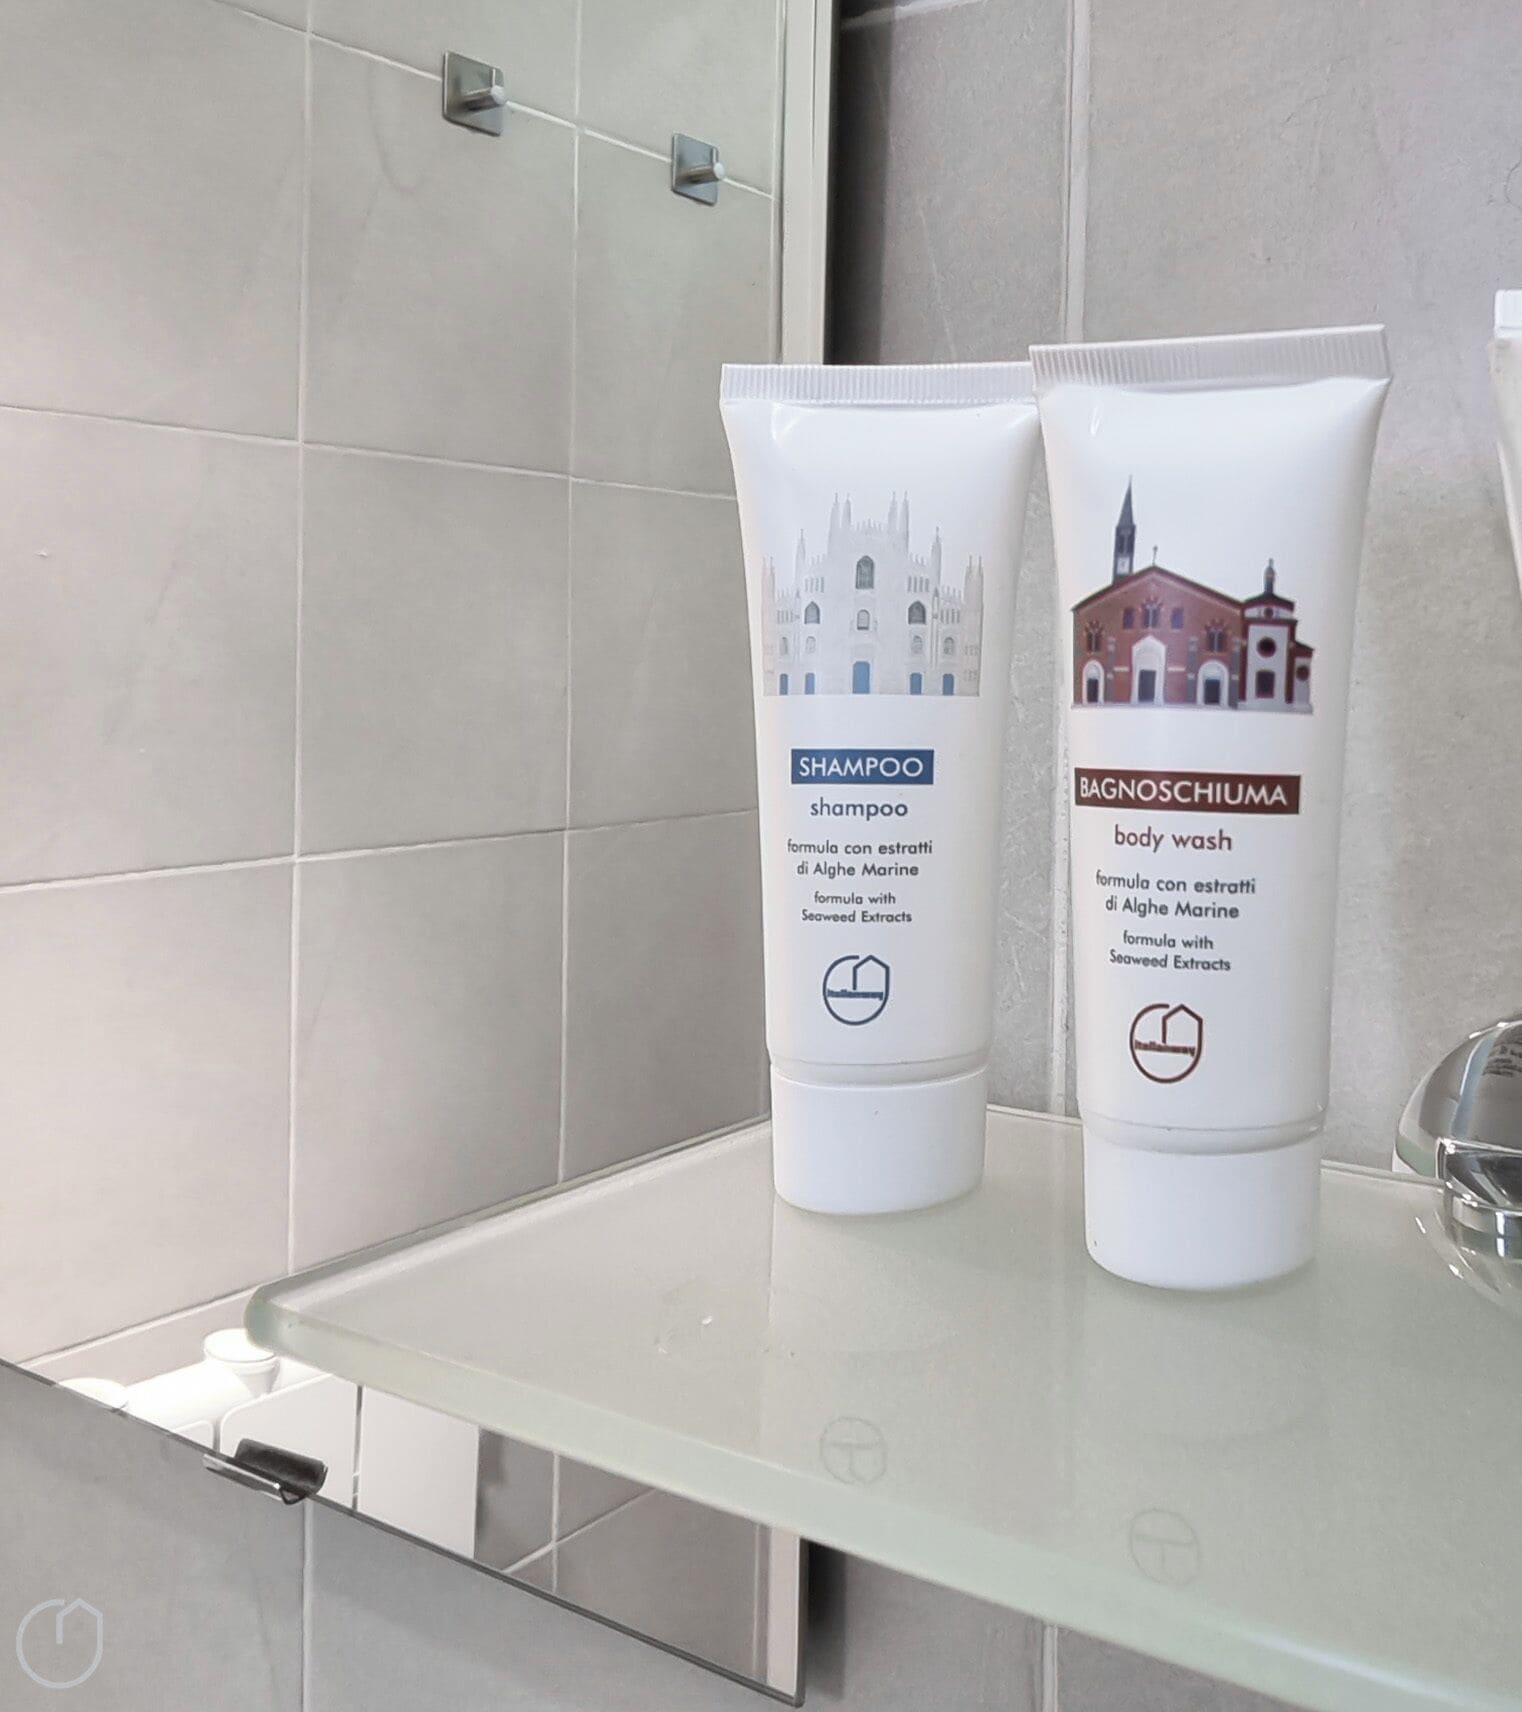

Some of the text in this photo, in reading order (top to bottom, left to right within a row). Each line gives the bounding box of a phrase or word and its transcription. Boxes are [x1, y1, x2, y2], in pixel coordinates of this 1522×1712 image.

[799, 757, 924, 777] SHAMPOO
[1080, 777, 1287, 807] BAGNOSCHIUMA
[810, 797, 908, 821] shampoo
[787, 839, 933, 855] formula con estratti
[1114, 824, 1232, 853] body wash
[797, 861, 919, 879] di Alghe Marine
[1096, 870, 1256, 894] formula con estratti
[814, 891, 896, 905] formula with
[1105, 895, 1240, 919] di Alghe Marine
[801, 909, 912, 923] Seaweed Extracts
[1123, 930, 1214, 950] formula with
[1109, 949, 1231, 971] Seaweed Extracts
